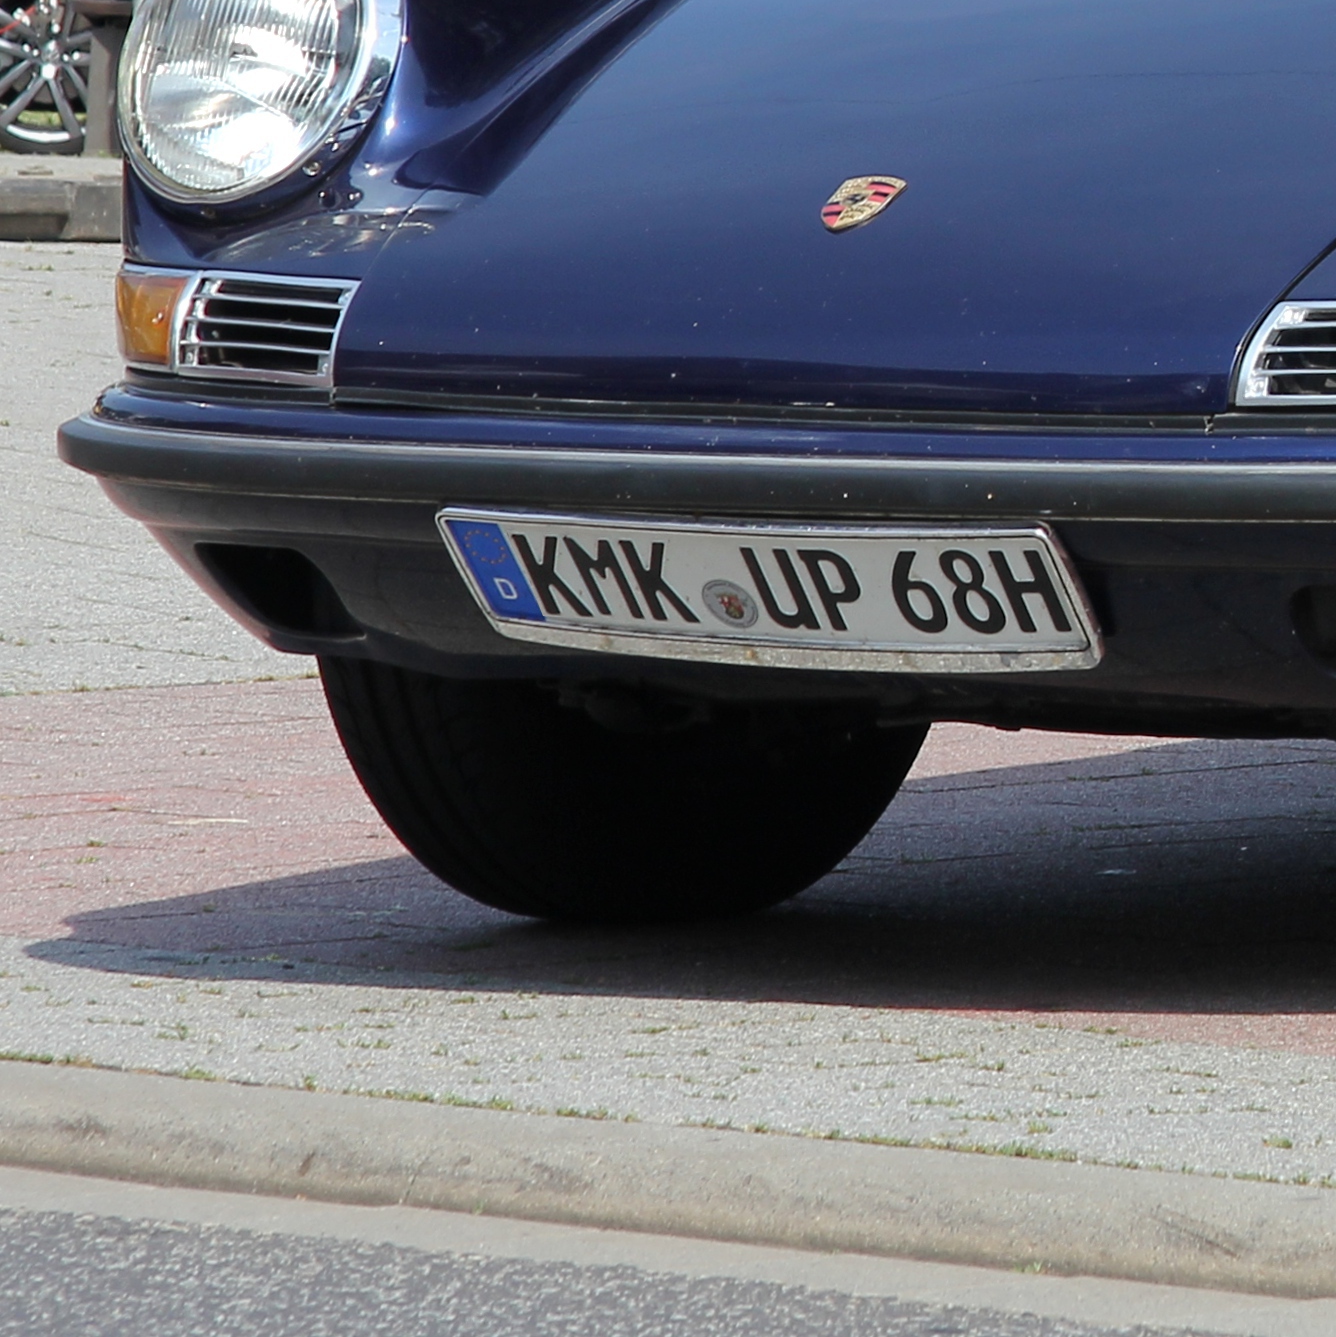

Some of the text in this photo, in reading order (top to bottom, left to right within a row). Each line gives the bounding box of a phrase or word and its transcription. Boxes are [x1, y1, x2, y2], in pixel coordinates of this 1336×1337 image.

[494, 578, 518, 599] D
[511, 532, 701, 624] KMK
[738, 546, 862, 633] UP
[891, 548, 1073, 635] 68H
